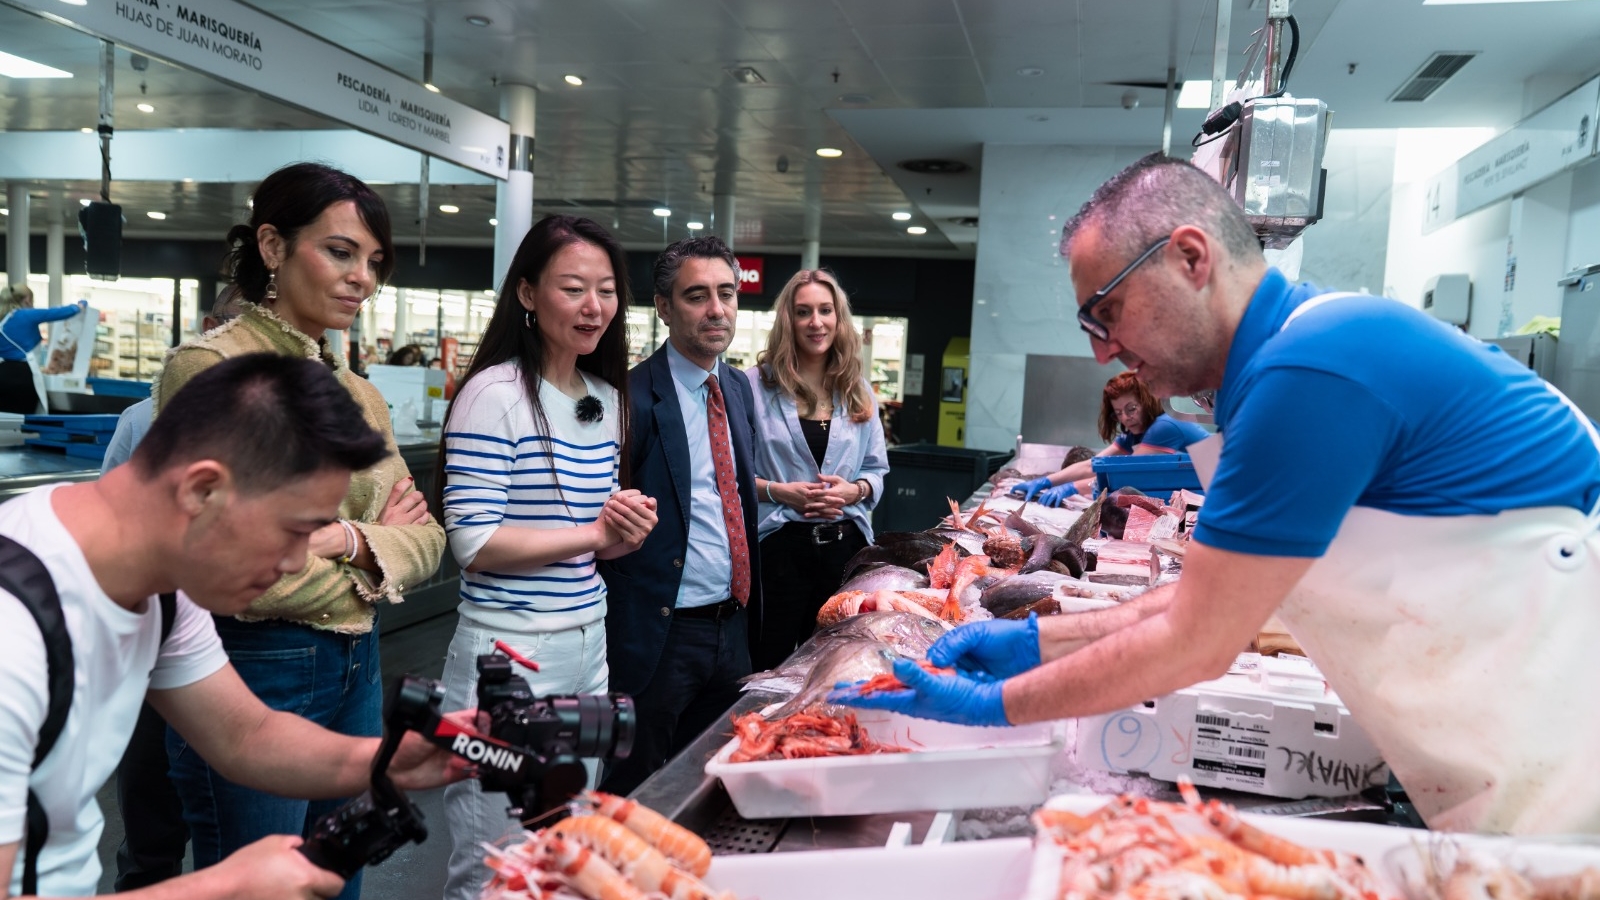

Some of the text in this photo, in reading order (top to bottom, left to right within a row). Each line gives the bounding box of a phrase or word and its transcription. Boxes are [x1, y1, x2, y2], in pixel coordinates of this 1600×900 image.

[116, 2, 152, 28] HIJAS
[156, 17, 174, 36] DE
[177, 27, 209, 50] JUAN
[212, 41, 262, 70] MORATO
[176, 4, 262, 51] MARISQUERÍA
[337, 72, 451, 129] PESCADERÍA MARISQUERÍA
[358, 99, 450, 144] LIDIA LORETO Y MARIBEL
[452, 732, 524, 773] RONIN
